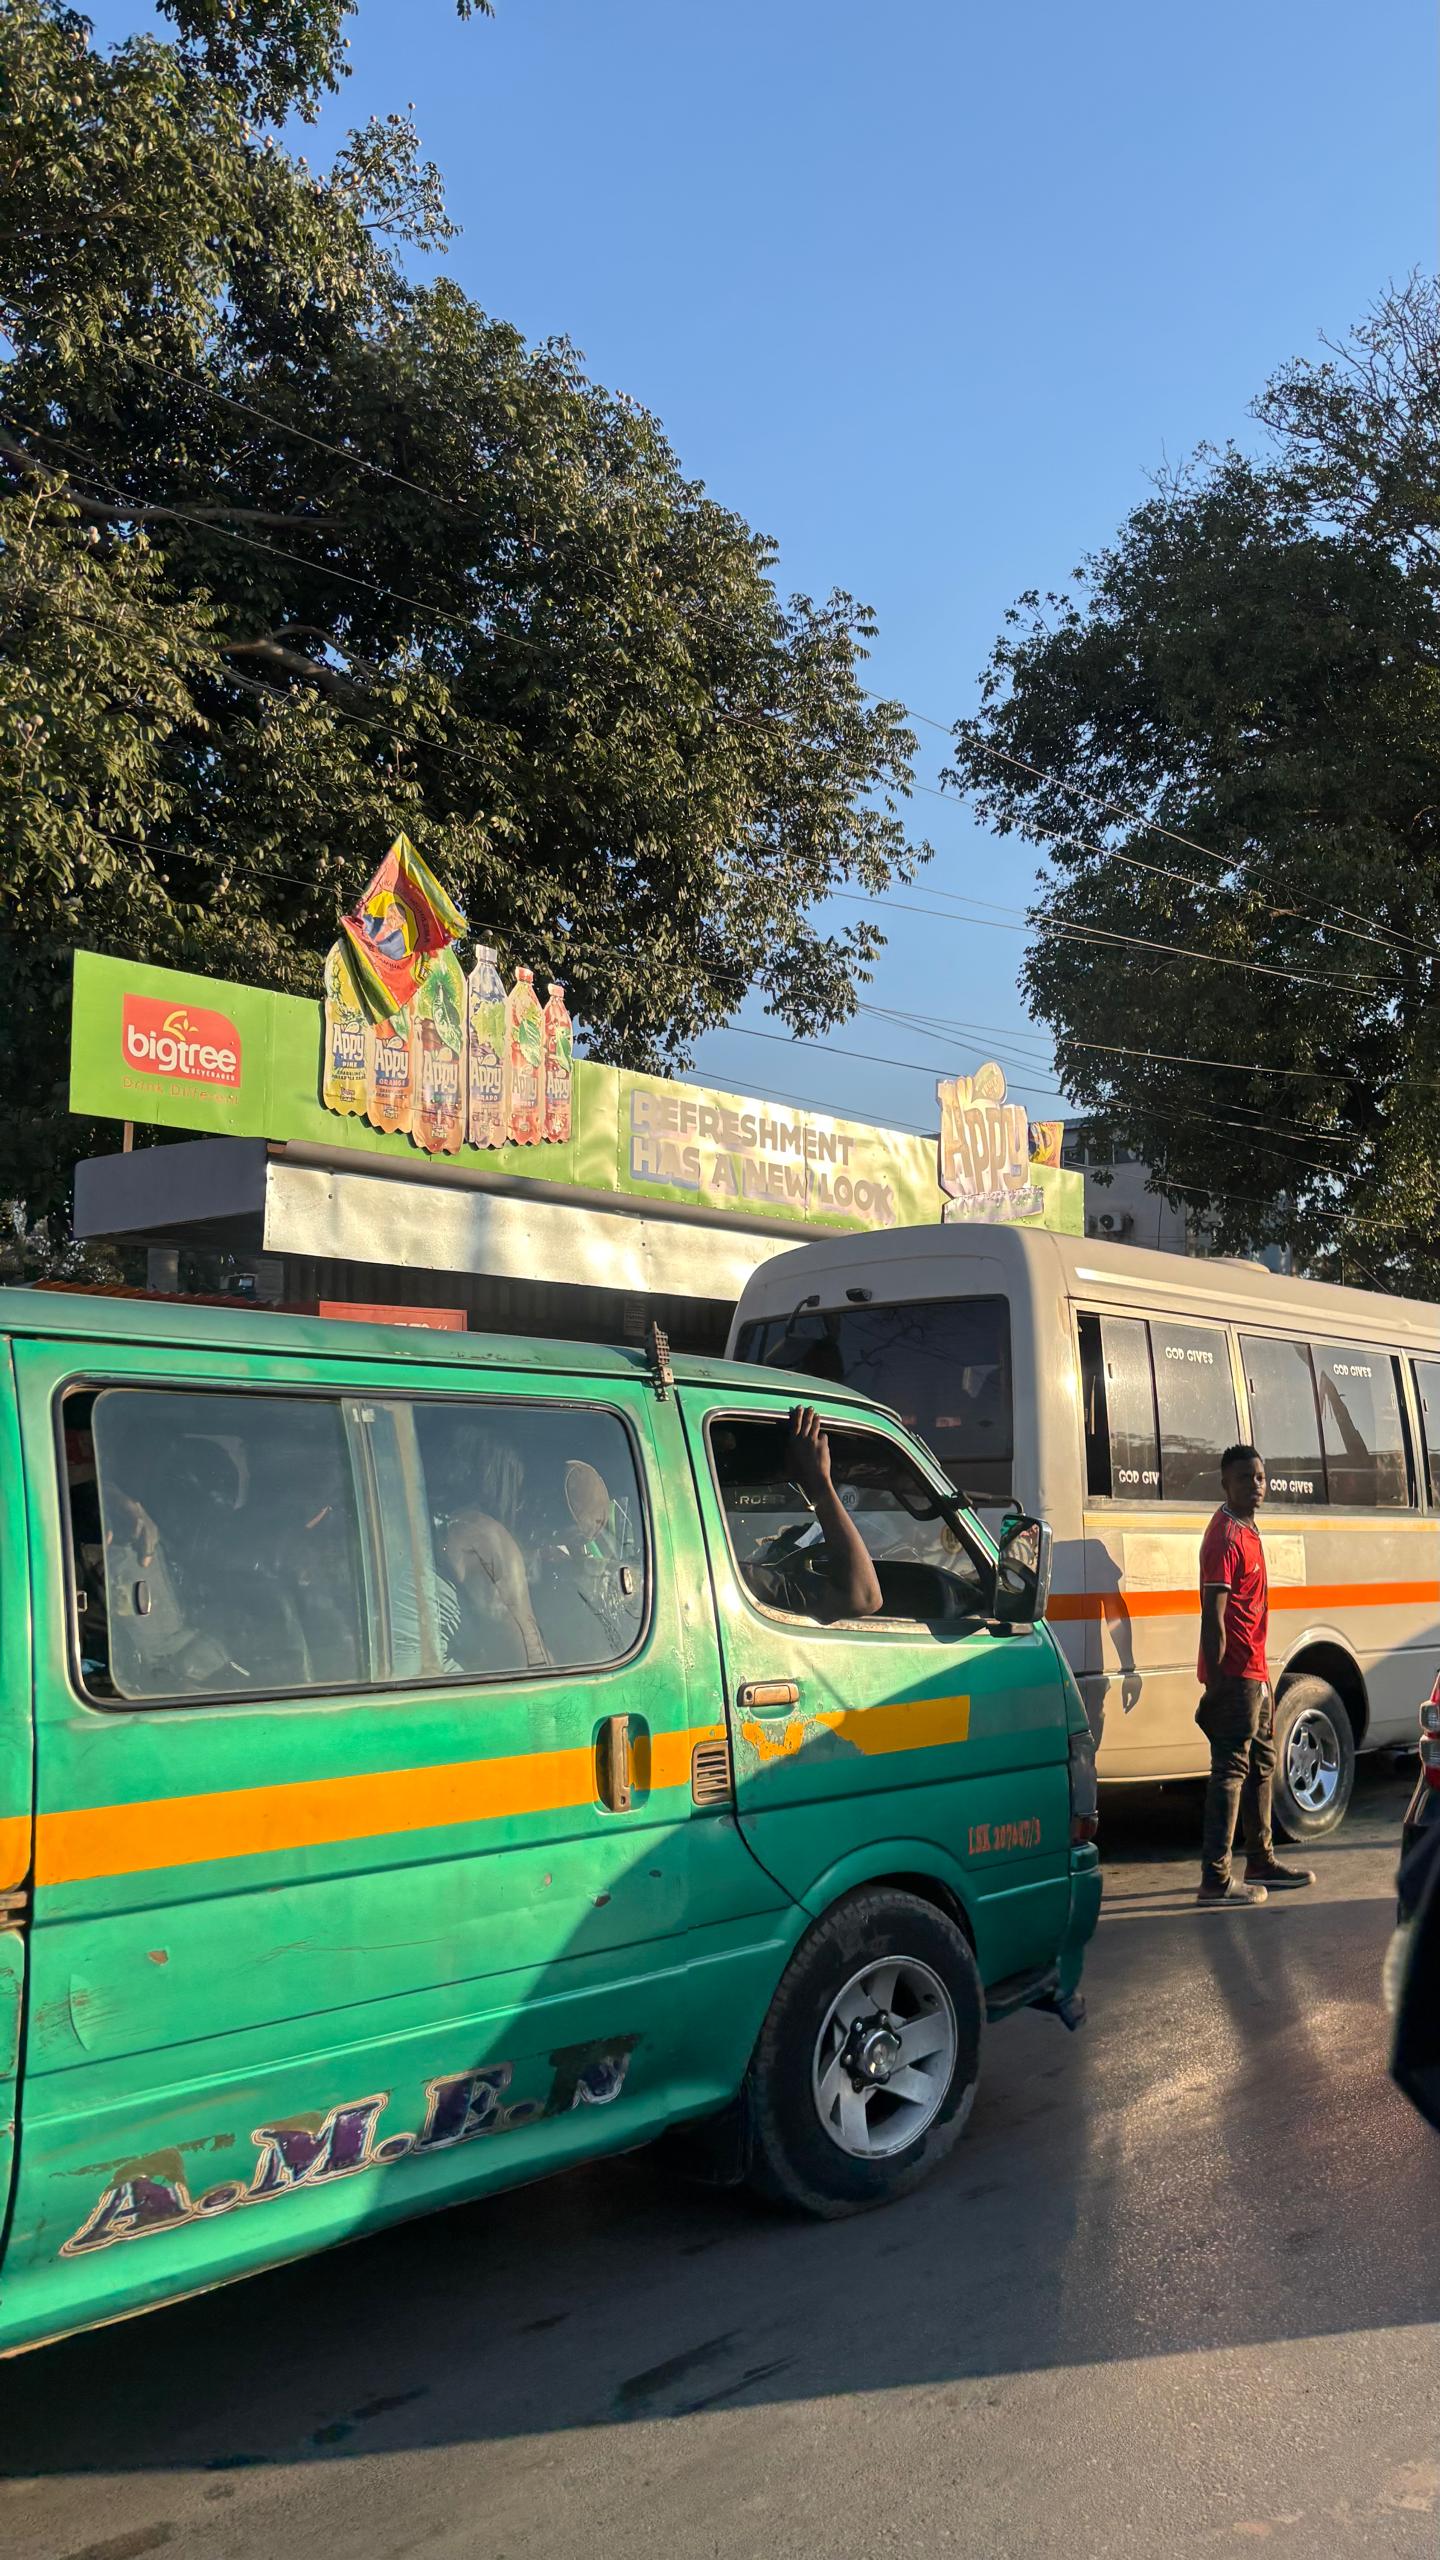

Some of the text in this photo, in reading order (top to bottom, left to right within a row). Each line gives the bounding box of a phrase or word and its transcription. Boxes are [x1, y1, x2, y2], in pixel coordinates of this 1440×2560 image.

[127, 1024, 237, 1074] bigtree
[332, 1022, 366, 1061] Appy
[375, 1038, 409, 1079] Appy
[190, 1067, 236, 1082] BEVERAGES
[422, 1050, 459, 1095] Appy
[470, 1055, 502, 1095] Appy
[632, 1090, 854, 1167] REFRESHMENT
[937, 1081, 1029, 1197] Appy
[632, 1136, 896, 1217] HAS A NEW LOOK
[1165, 1346, 1214, 1364] GOD GIVES
[1333, 1363, 1372, 1378] GOD GIVES
[1119, 1469, 1140, 1484] GOD
[1270, 1478, 1313, 1494] GOD GIVES
